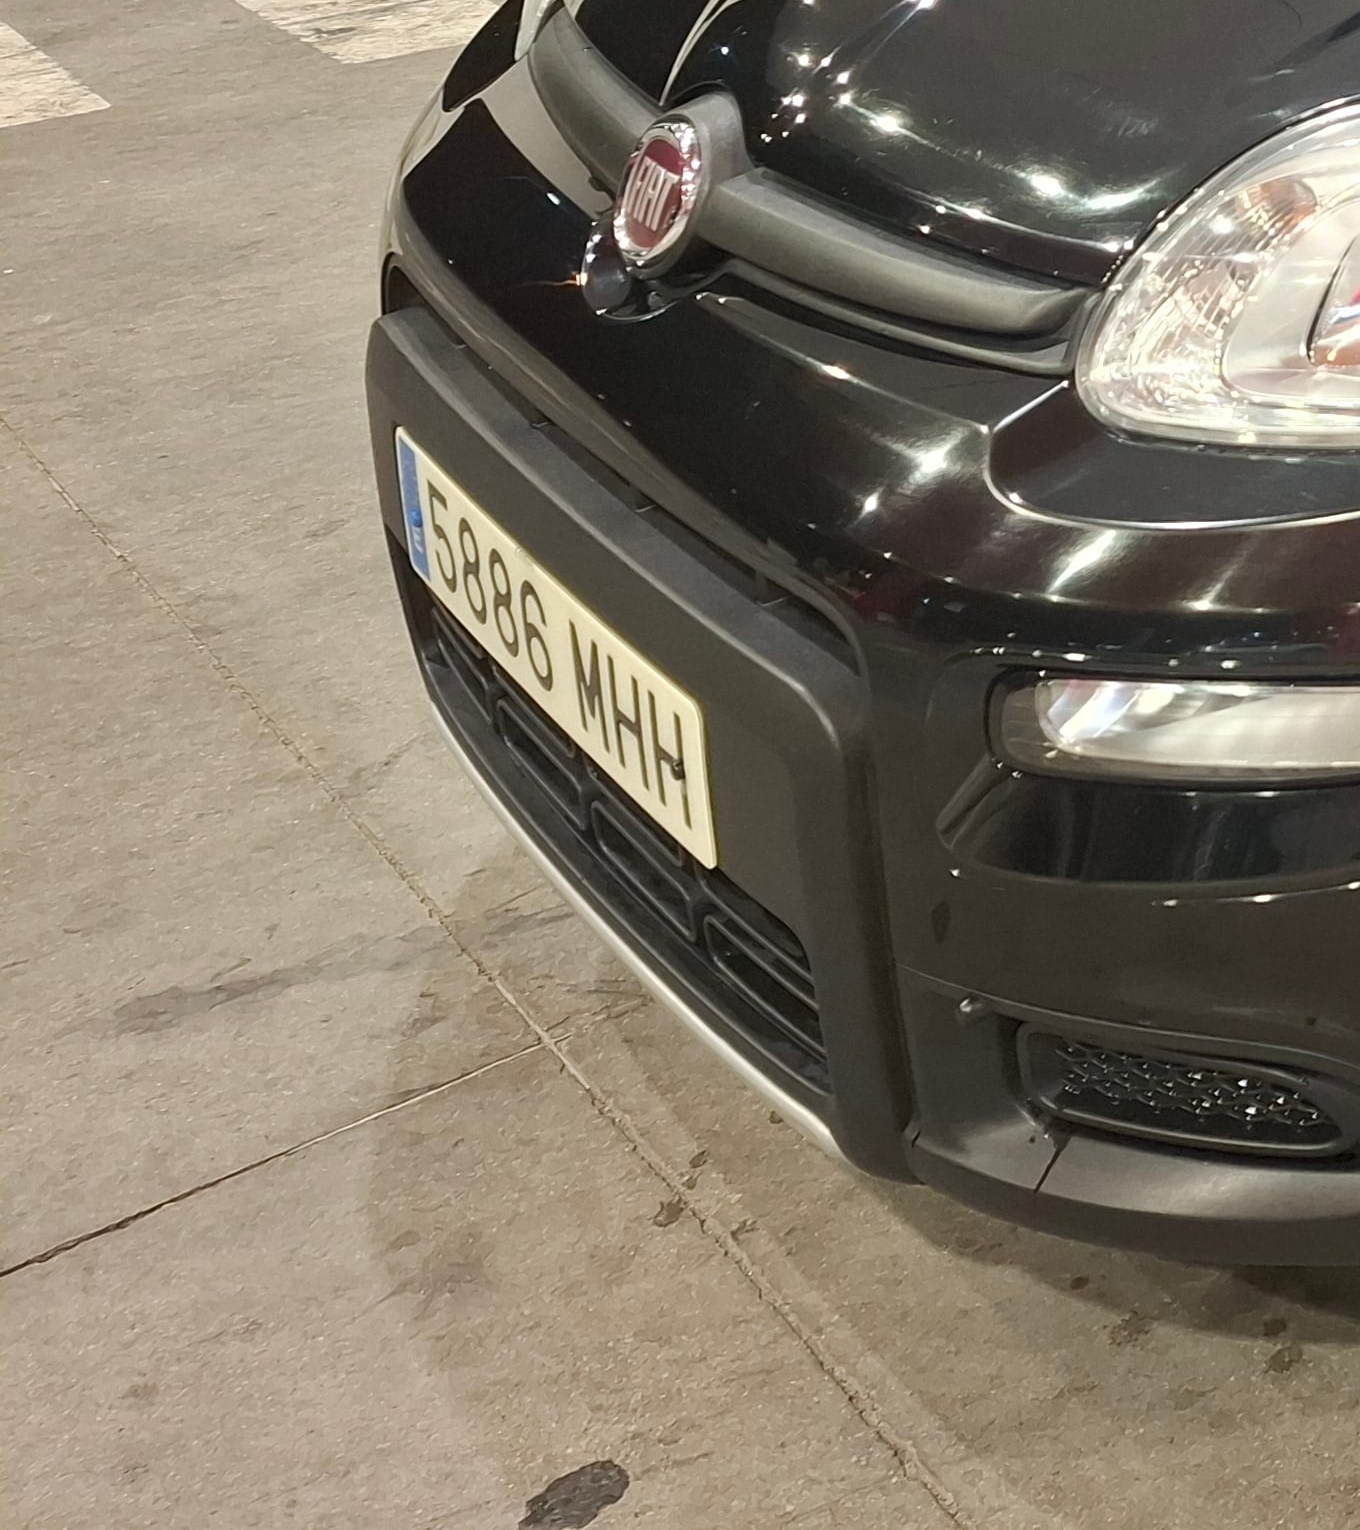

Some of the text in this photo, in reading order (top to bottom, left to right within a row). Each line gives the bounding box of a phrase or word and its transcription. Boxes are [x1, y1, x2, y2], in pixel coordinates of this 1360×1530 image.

[626, 155, 681, 232] FIAT
[426, 479, 693, 831] 5886 MHH
